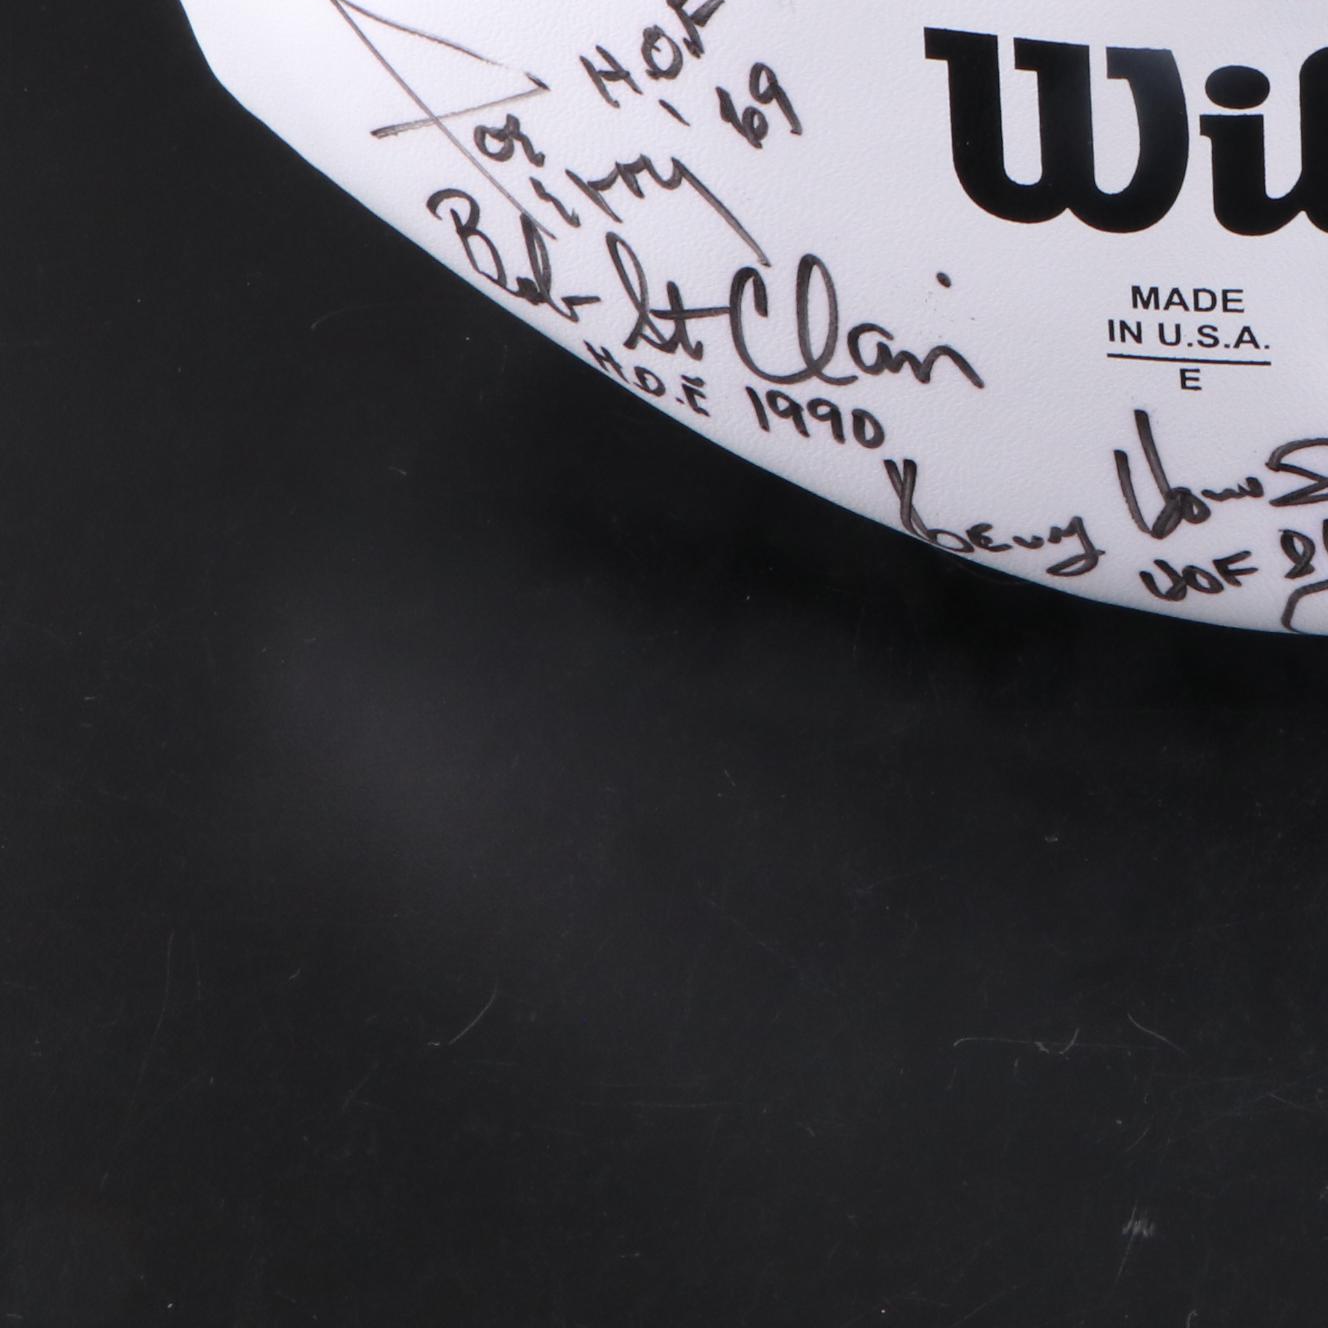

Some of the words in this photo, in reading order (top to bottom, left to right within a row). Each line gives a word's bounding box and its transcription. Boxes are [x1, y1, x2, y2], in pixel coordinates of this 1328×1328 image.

[1130, 283, 1246, 316] MADE
[1106, 317, 1143, 346] IN
[1156, 320, 1272, 353] U.S.A.
[1178, 369, 1203, 393] E
[745, 385, 886, 450] 1990
